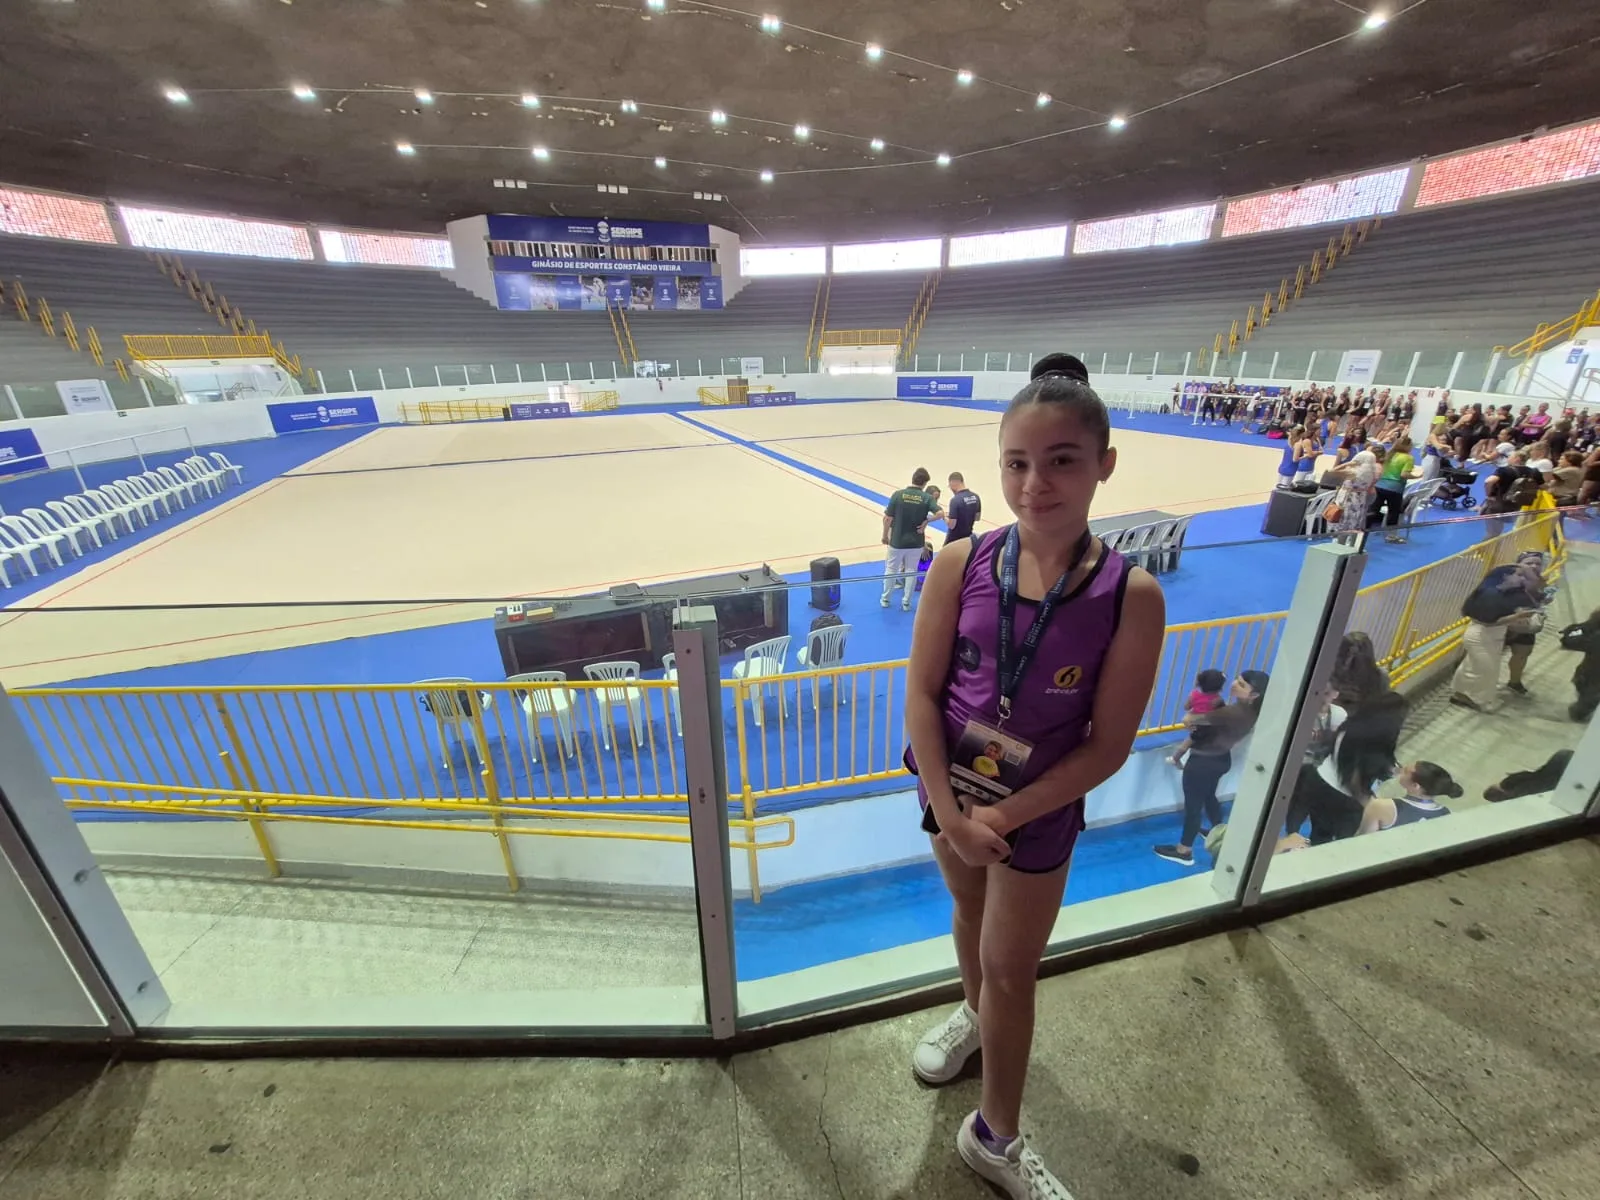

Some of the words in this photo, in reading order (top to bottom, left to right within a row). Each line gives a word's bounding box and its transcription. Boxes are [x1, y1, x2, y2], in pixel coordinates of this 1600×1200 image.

[531, 259, 563, 269] GINÁSIO
[564, 261, 575, 269] DE
[575, 262, 613, 270] ESPORTES
[613, 261, 658, 271] CONSTÂNCIO
[658, 264, 682, 272] VIEIRA
